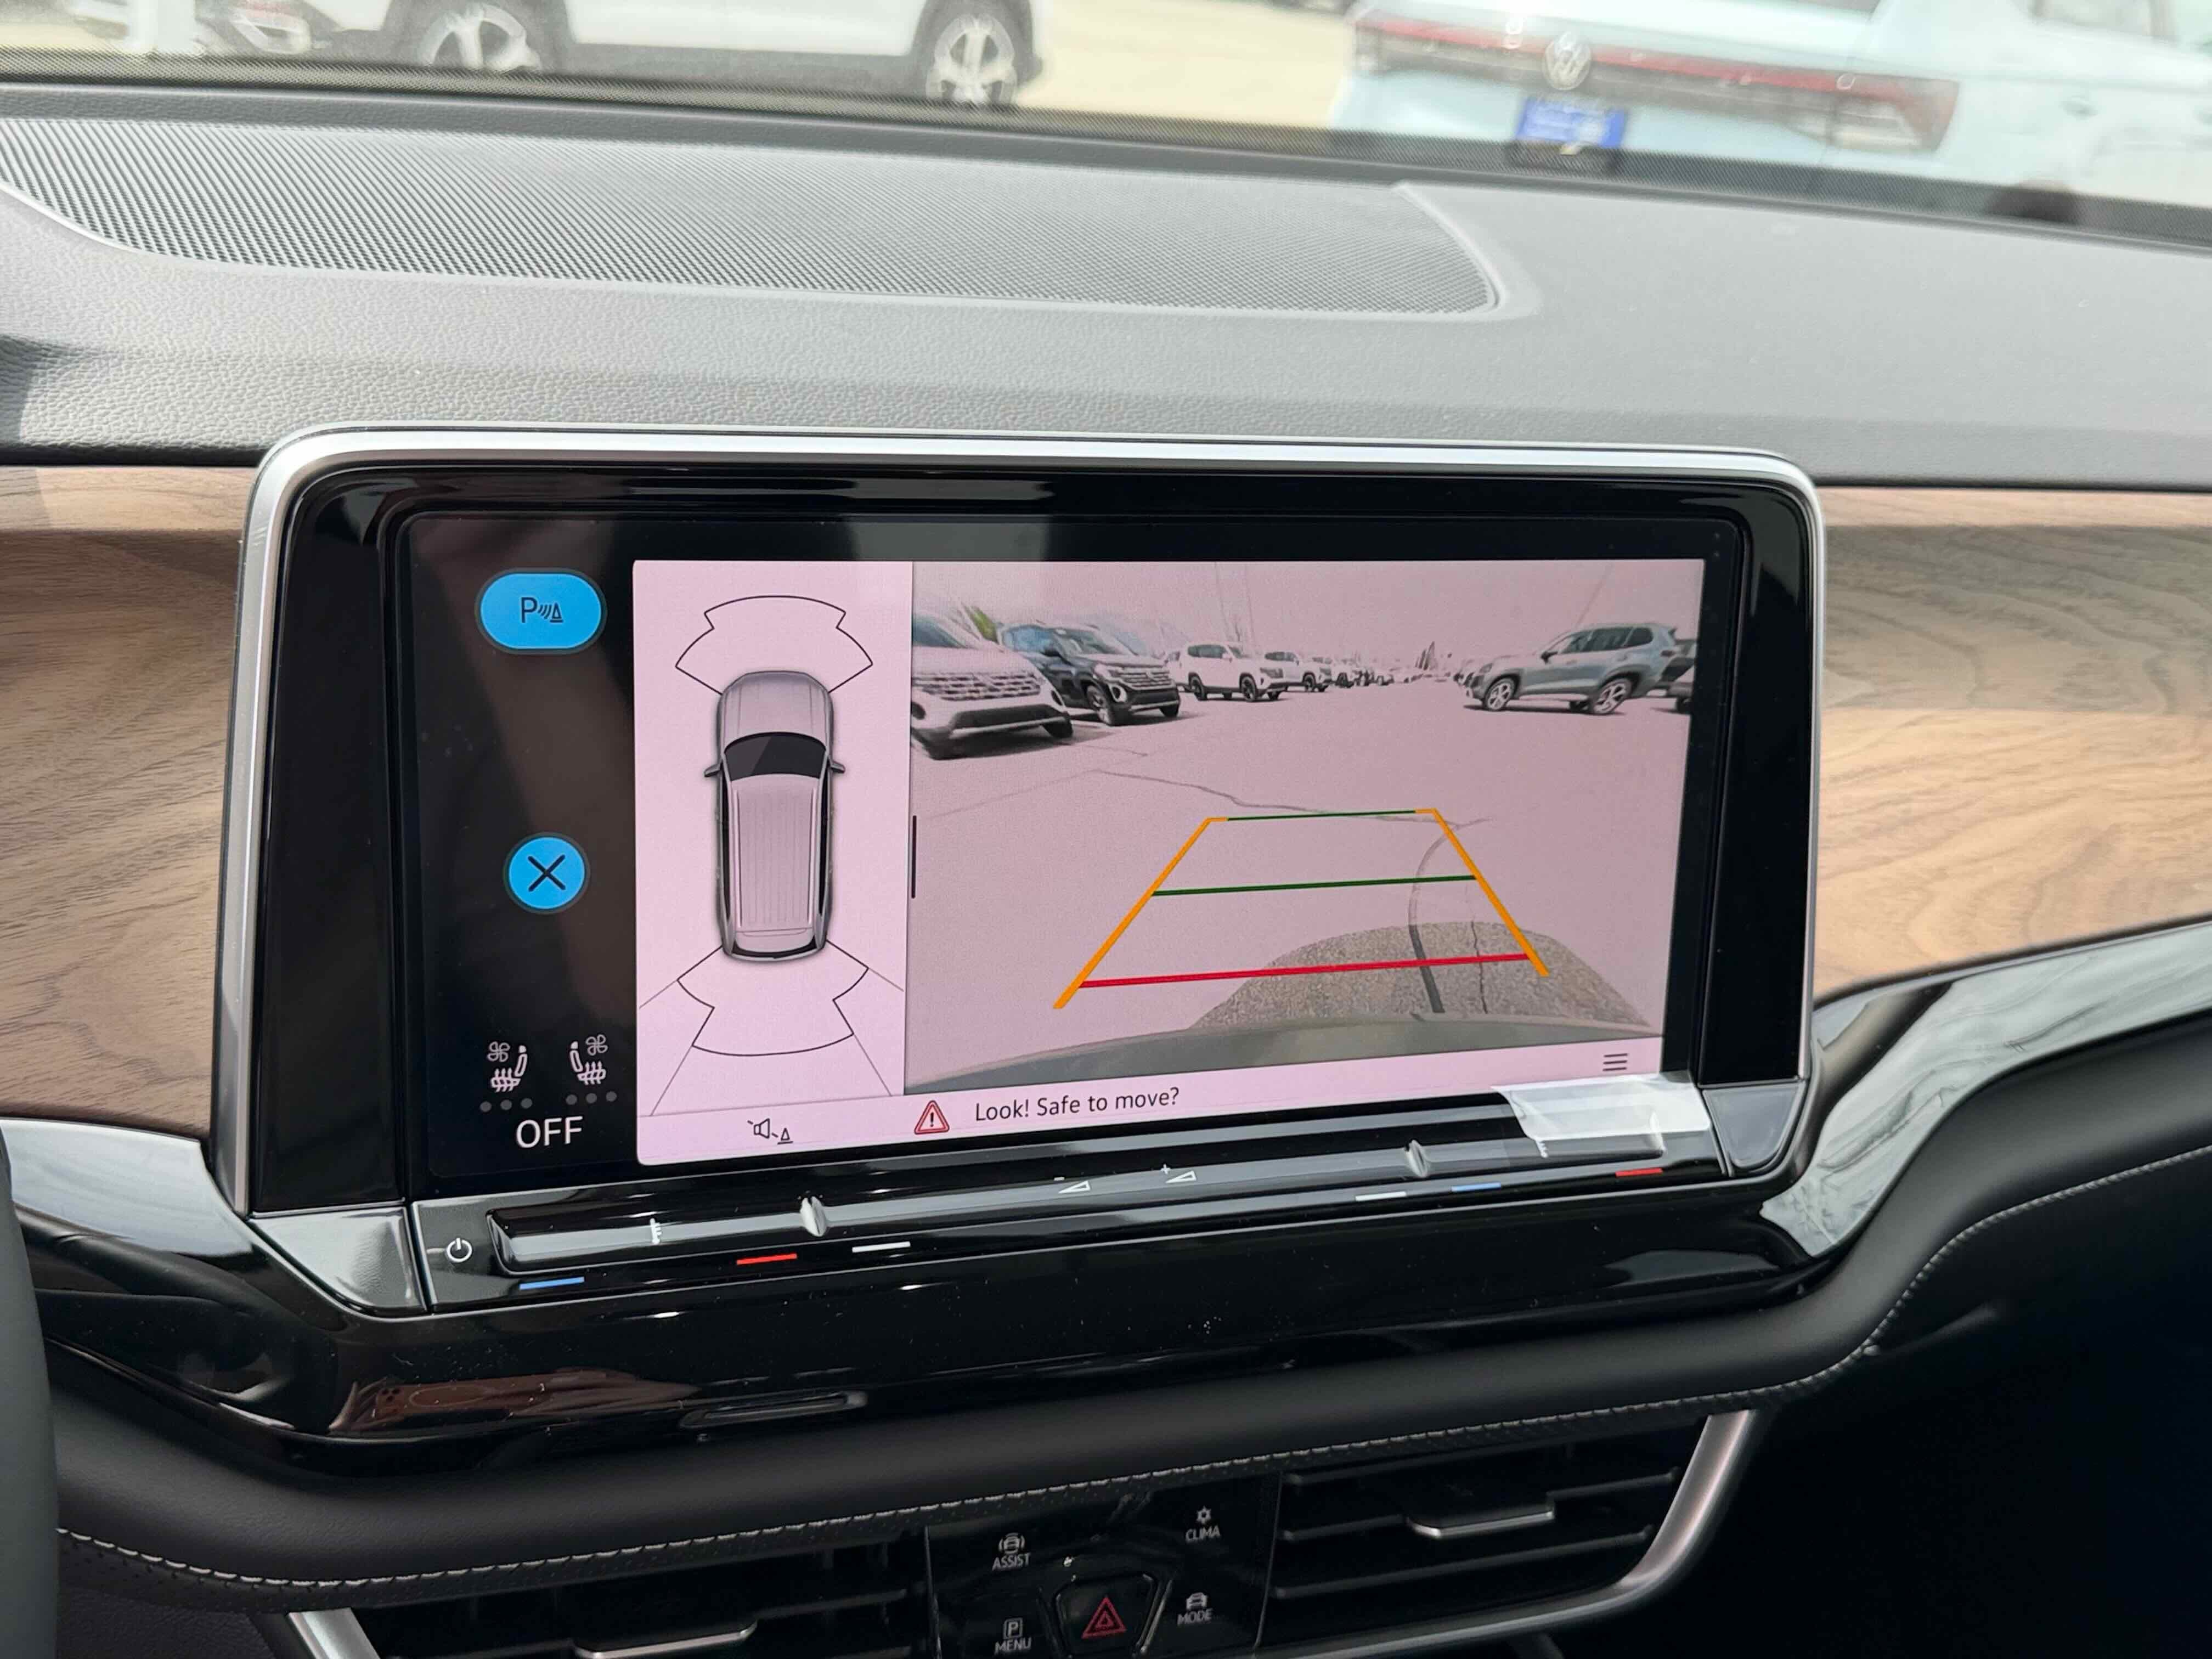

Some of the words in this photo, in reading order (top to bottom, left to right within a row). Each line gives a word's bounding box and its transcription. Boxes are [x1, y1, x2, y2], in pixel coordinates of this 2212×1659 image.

[975, 1099, 1030, 1122] Look!
[1037, 1096, 1080, 1116] Safe
[1087, 1095, 1108, 1113] to
[1115, 1086, 1180, 1110] move?
[515, 1115, 583, 1149] OFF
[1185, 1525, 1221, 1542] CLIMA
[991, 1552, 1031, 1572] ASSIST
[1177, 1608, 1212, 1626] MODE
[995, 1637, 1032, 1655] MENU
